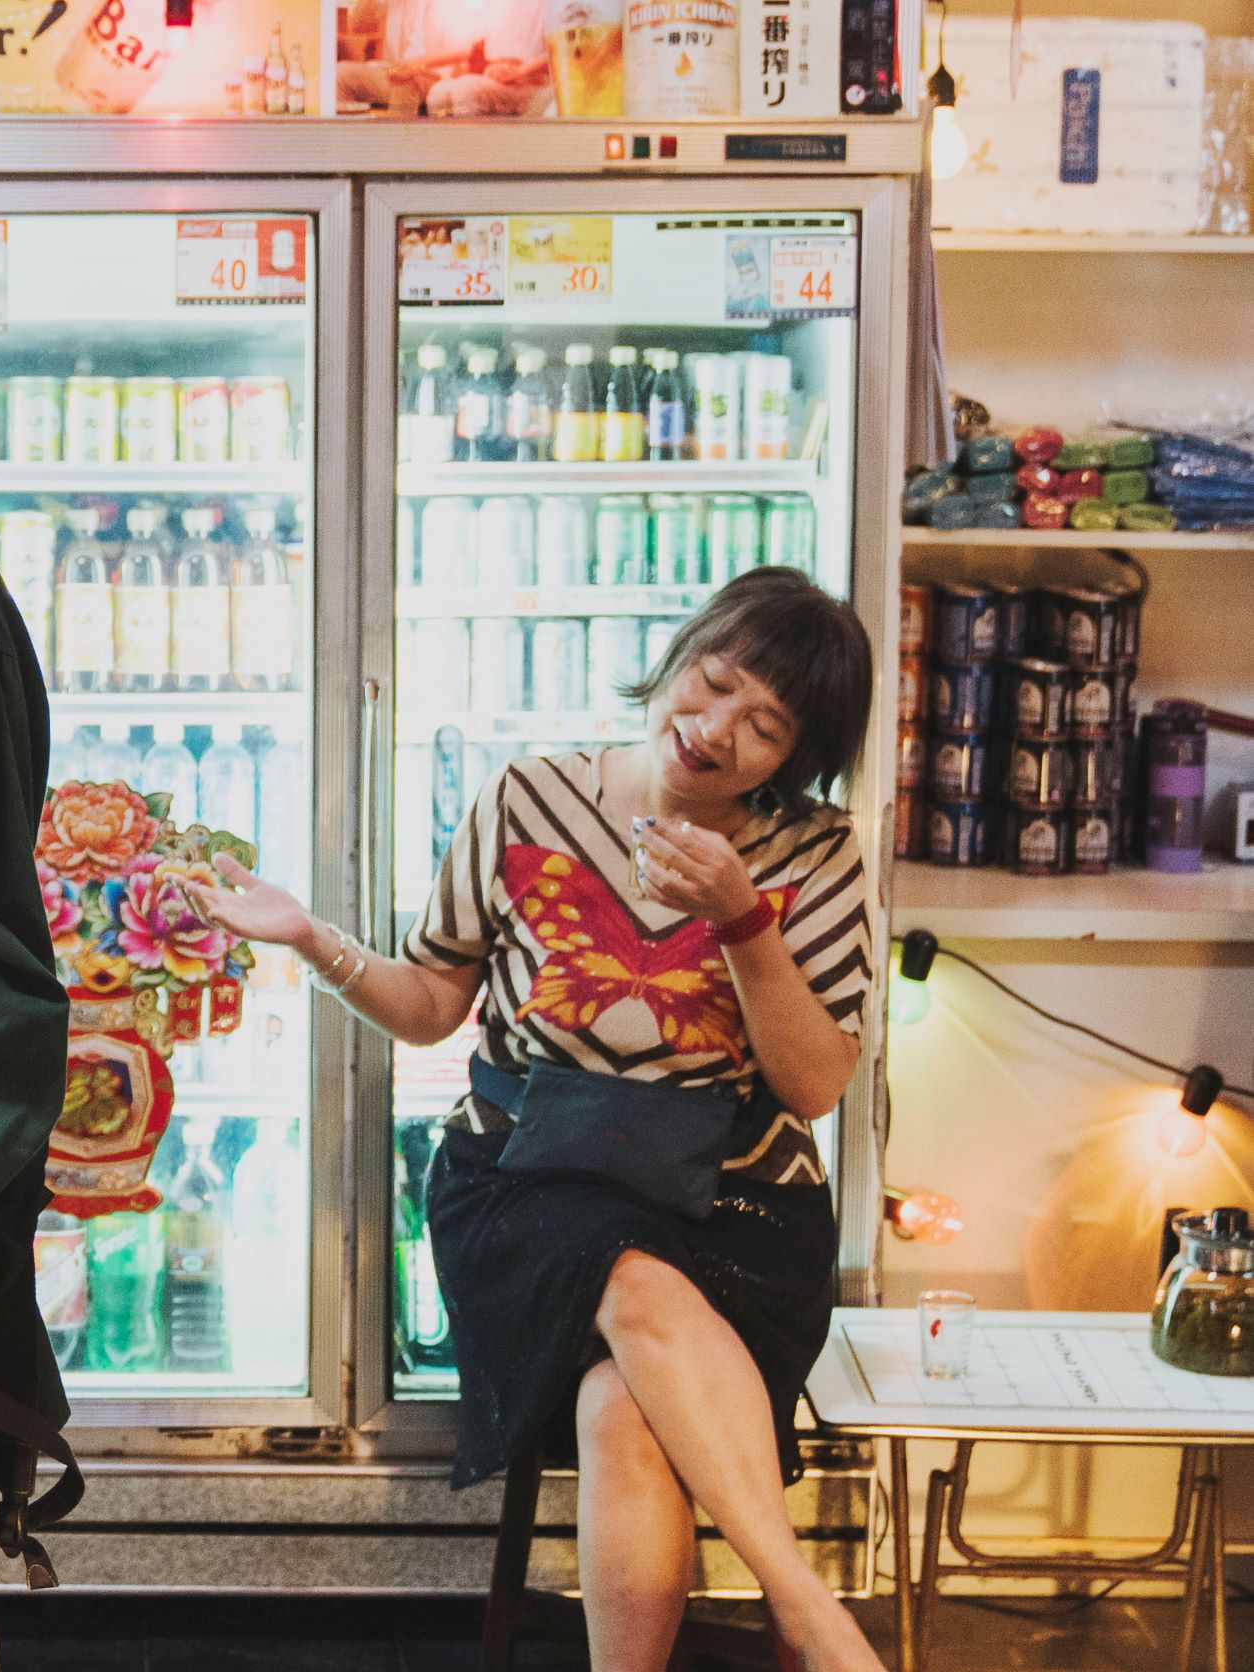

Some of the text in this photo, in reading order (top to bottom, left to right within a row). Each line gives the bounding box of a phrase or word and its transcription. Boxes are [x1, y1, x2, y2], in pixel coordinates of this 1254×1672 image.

[210, 259, 246, 291] 40
[455, 272, 492, 296] 35
[562, 265, 598, 292] 30
[799, 271, 833, 303] 44
